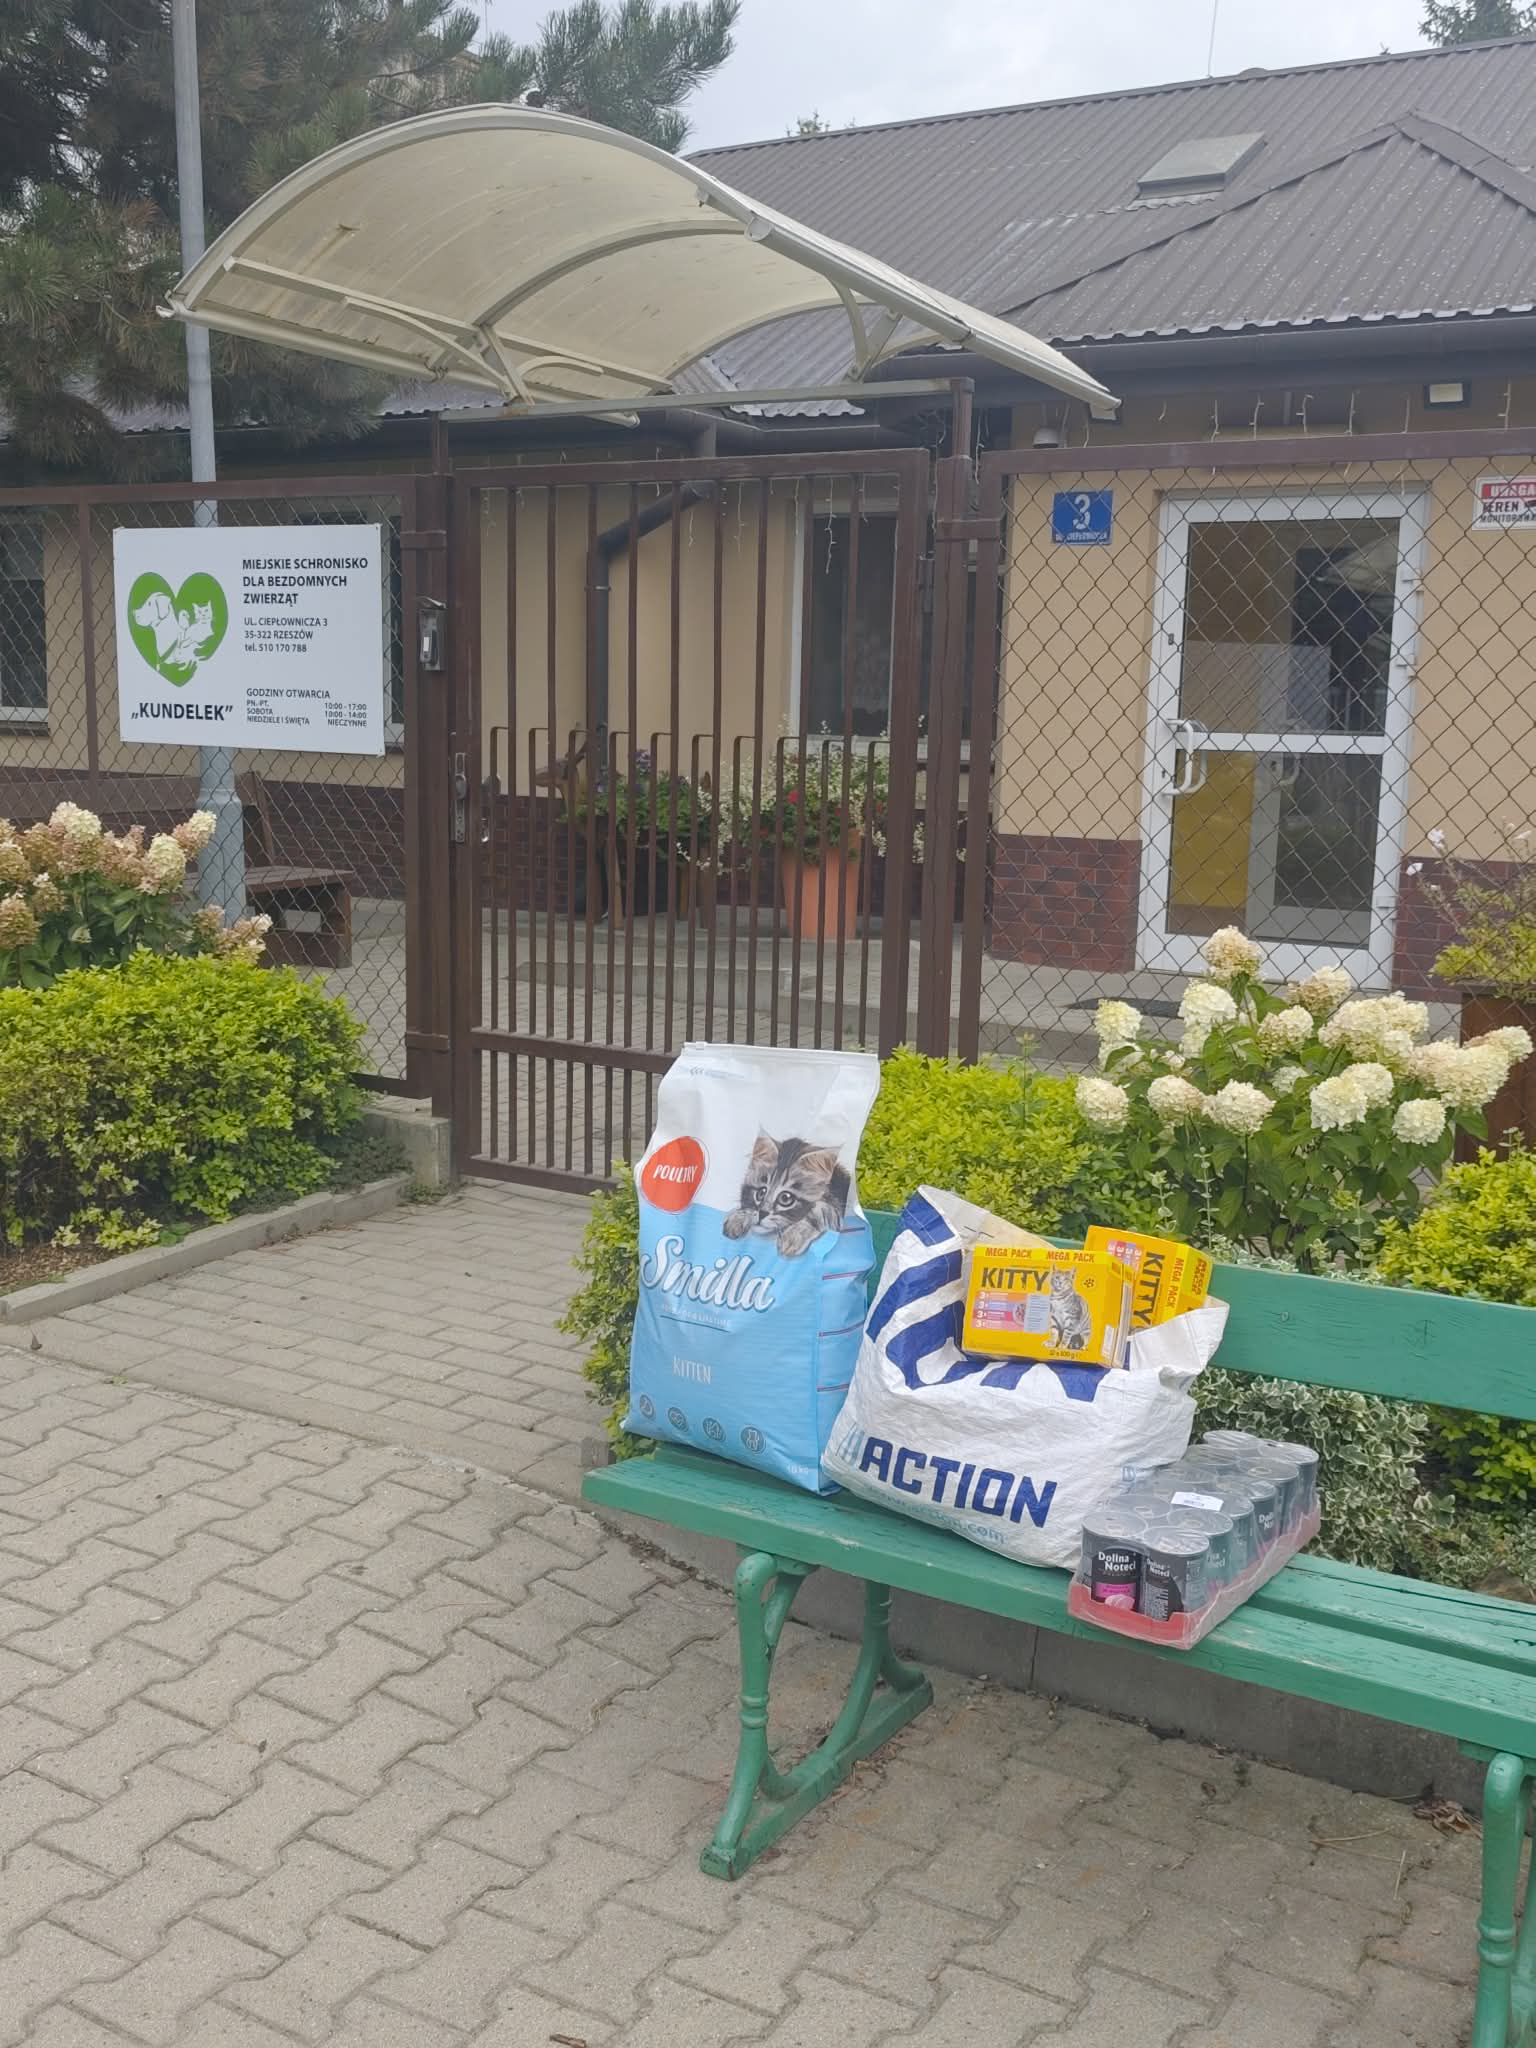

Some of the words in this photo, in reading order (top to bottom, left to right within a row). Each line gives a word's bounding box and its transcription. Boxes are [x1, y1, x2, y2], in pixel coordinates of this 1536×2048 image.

[1072, 494, 1091, 530] 3
[242, 558, 292, 570] MIEJSKIE
[294, 557, 368, 569] SCHRONISKO
[243, 576, 265, 587] DLA
[267, 575, 347, 587] BEZDOMNYCH
[243, 593, 299, 607] ZWIERZĄT
[244, 617, 257, 626] UL.
[258, 617, 321, 627] CIEPŁOWNICZA
[323, 618, 328, 627] 3
[244, 630, 272, 639] 35-322
[273, 629, 314, 640] RZESZÓW
[244, 643, 257, 652] tel.
[259, 643, 274, 652] 510
[276, 643, 290, 652] 170
[246, 688, 284, 698] GODZINY
[285, 689, 331, 699] OTWARCIA
[246, 707, 274, 715] SOBOTA
[247, 715, 281, 724] NIEDZIELE
[327, 719, 367, 727] NIECZYNNE
[985, 1248, 1008, 1257] MEGA
[1011, 1248, 1032, 1258] PACK
[1046, 1251, 1070, 1261] MEGA
[1073, 1252, 1095, 1263] PACK
[640, 1234, 776, 1313] Smilla
[1171, 1257, 1185, 1282] MEGA
[981, 1267, 1050, 1291] KITTY
[1133, 1252, 1166, 1326] KITTY
[1167, 1285, 1179, 1308] PACK
[858, 1436, 1058, 1528] ACTION
[1098, 1551, 1130, 1563] Dolina
